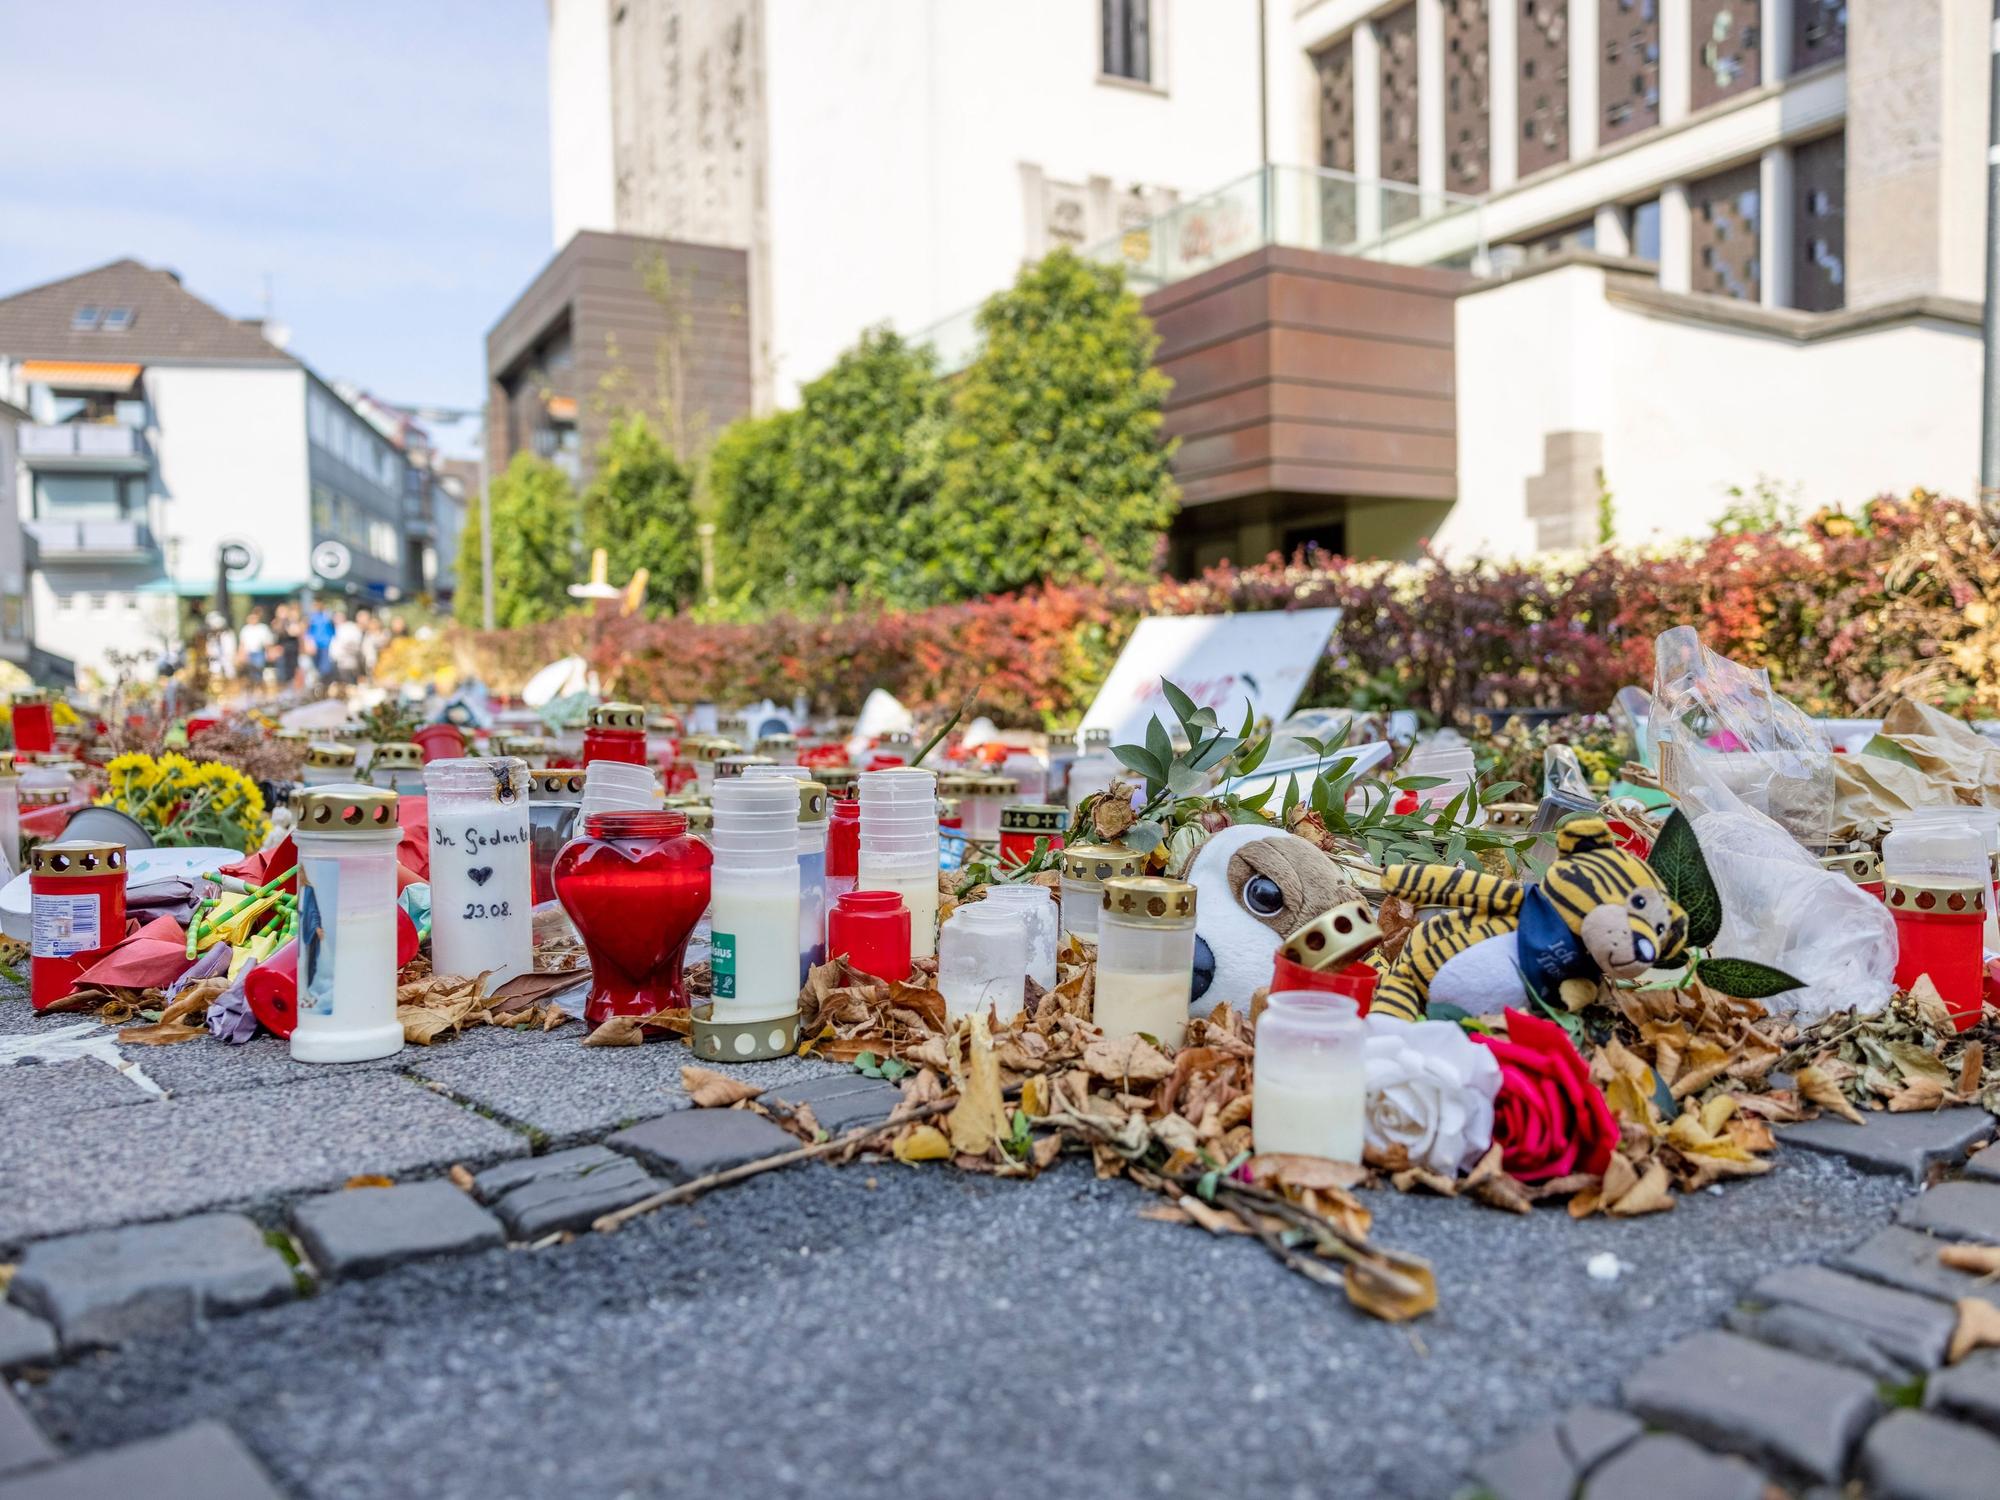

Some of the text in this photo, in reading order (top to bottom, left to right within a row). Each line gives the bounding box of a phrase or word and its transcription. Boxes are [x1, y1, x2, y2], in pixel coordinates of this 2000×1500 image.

[435, 827, 456, 846] In
[463, 901, 512, 919] 23.08.
[1547, 940, 1578, 964] Ich
